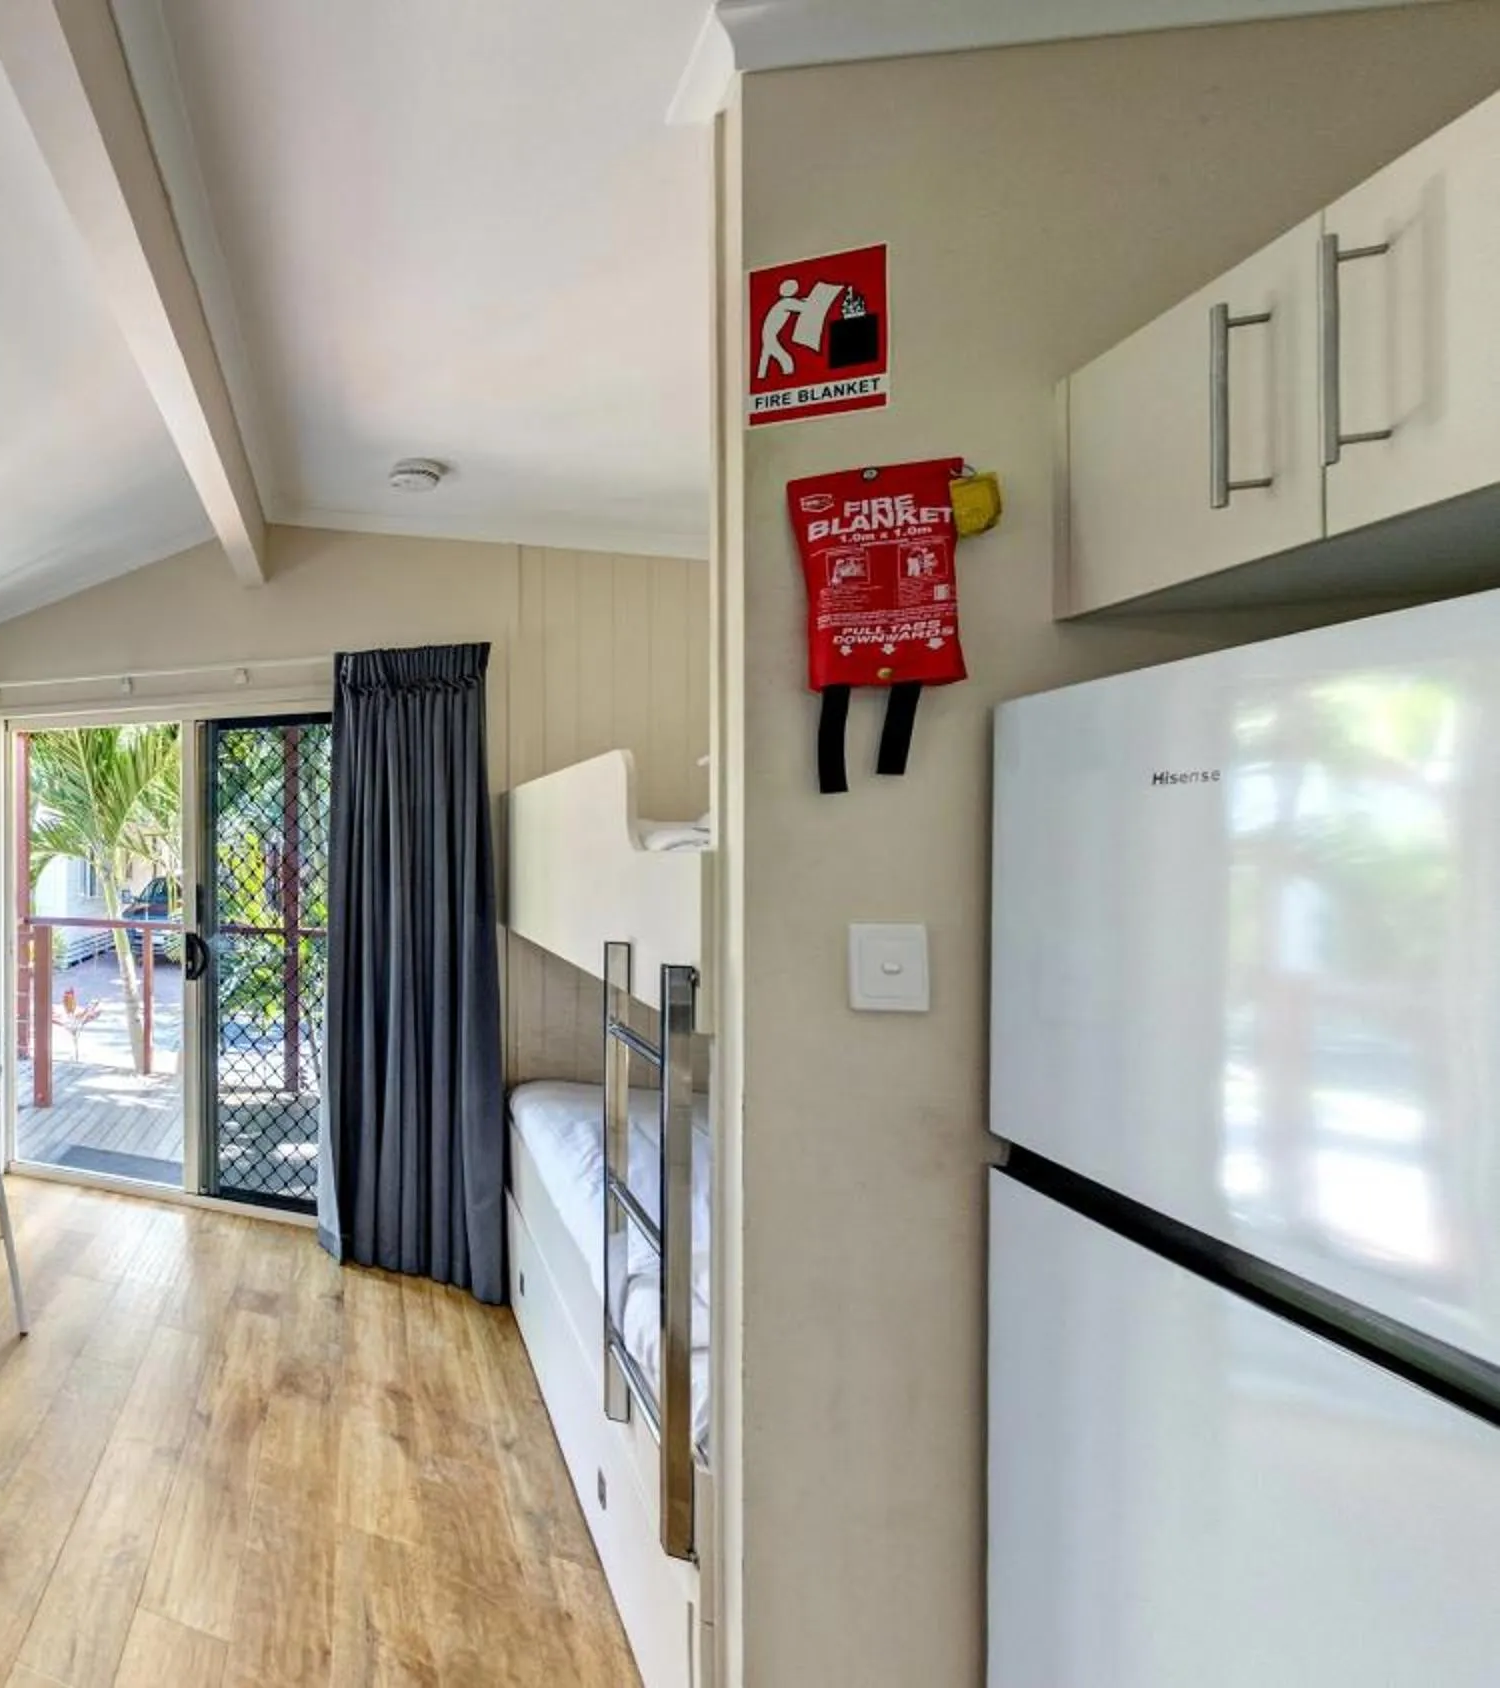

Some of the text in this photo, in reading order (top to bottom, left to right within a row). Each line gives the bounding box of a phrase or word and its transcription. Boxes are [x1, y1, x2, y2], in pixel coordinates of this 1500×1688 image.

[755, 377, 880, 410] FIRE BLANKET
[843, 493, 915, 517] FIRE
[807, 507, 953, 542] BLANKET
[833, 625, 954, 645] DOWNWARDS
[842, 619, 941, 635] PULL TABS
[1151, 768, 1221, 785] Hisense
